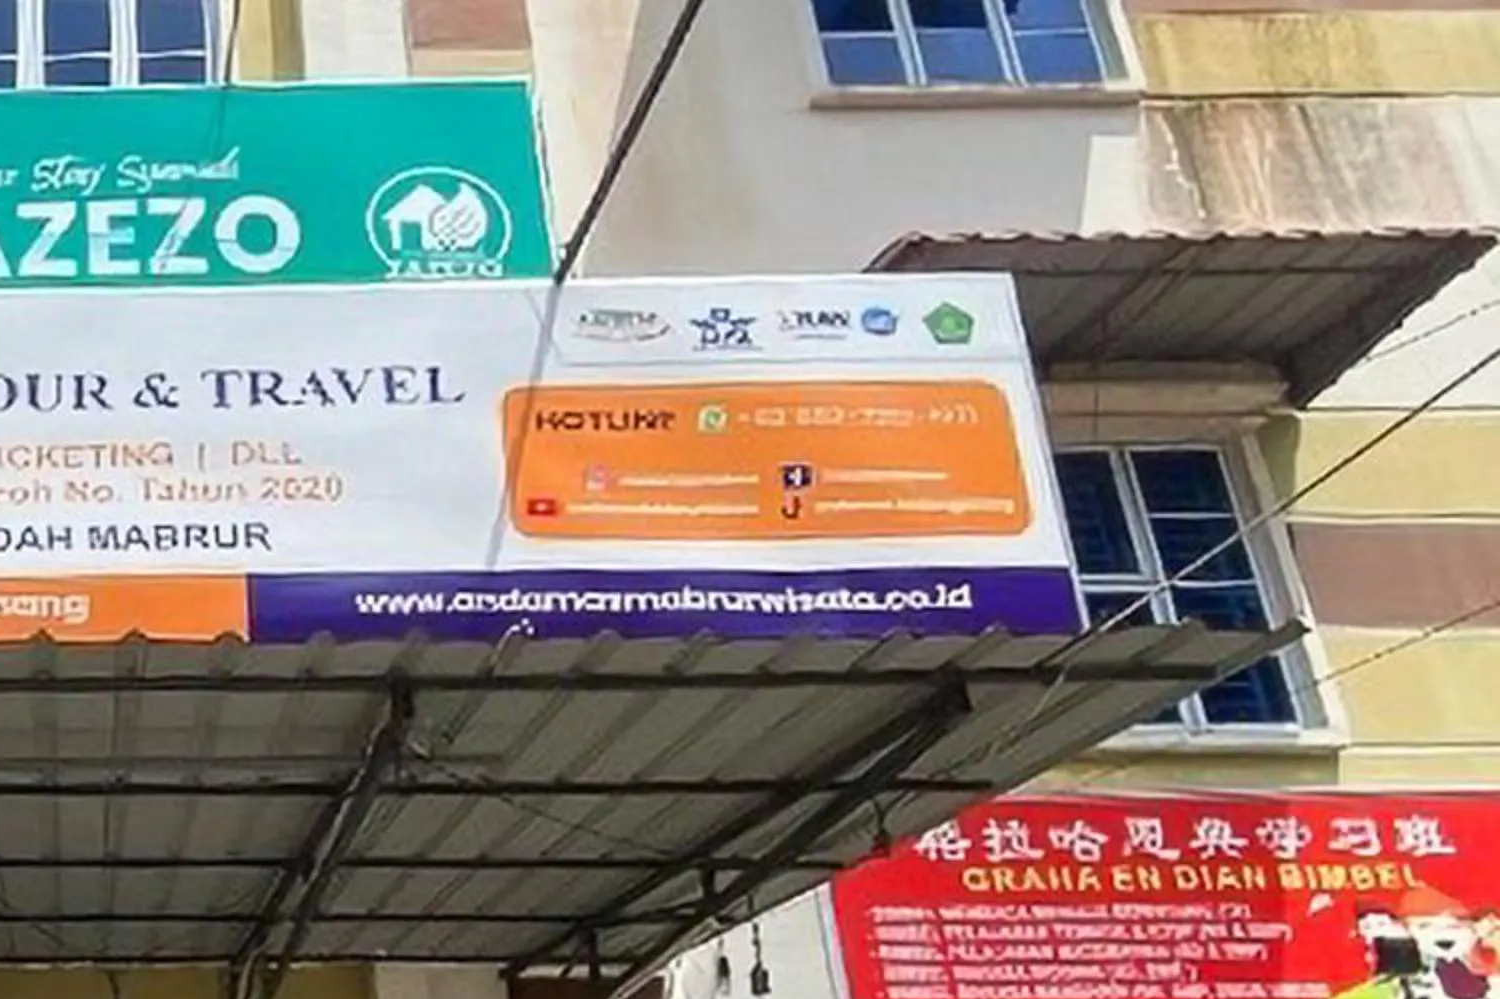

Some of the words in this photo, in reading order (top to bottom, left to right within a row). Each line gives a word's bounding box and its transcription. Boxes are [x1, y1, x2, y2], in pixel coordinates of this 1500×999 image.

[31, 154, 107, 196] Stay
[132, 372, 180, 409] &
[200, 365, 466, 409] TRAVEL
[87, 522, 273, 552] MABRUR
[1111, 864, 1163, 892] EN
[1171, 863, 1268, 891] DIAN
[1277, 862, 1426, 891] BIMBEL
